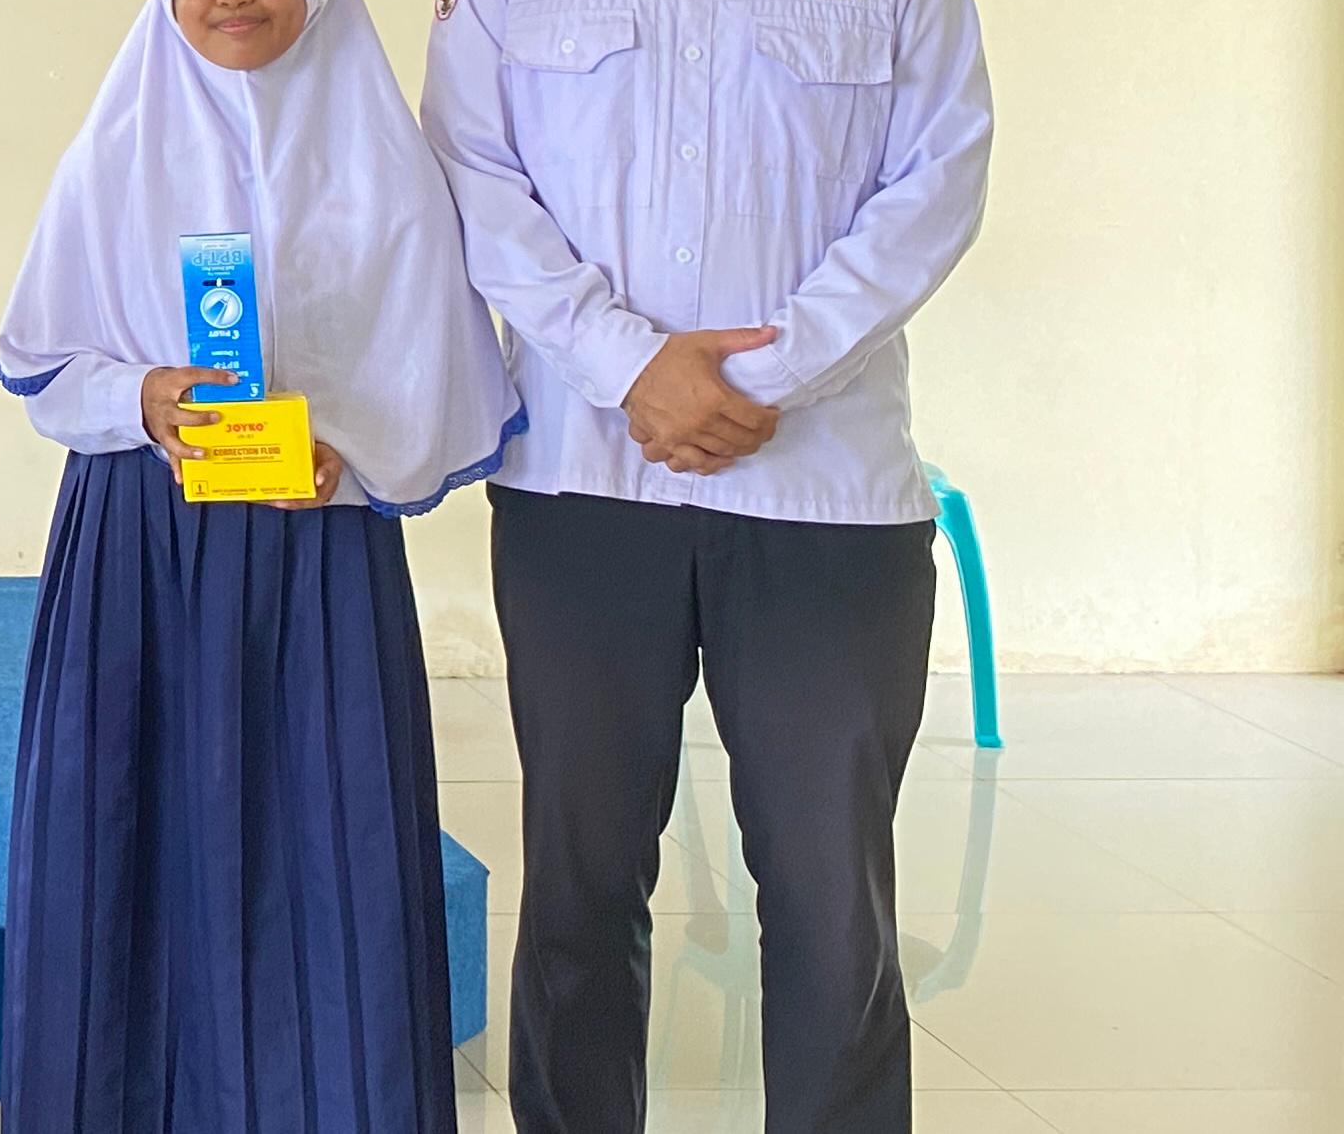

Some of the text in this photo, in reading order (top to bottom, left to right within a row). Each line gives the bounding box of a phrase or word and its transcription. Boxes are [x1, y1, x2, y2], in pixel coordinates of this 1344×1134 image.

[193, 250, 242, 265] BPT-P
[208, 330, 231, 338] PILOT
[225, 423, 264, 433] JOYKO
[213, 446, 281, 457] CORRECTION FLUID
